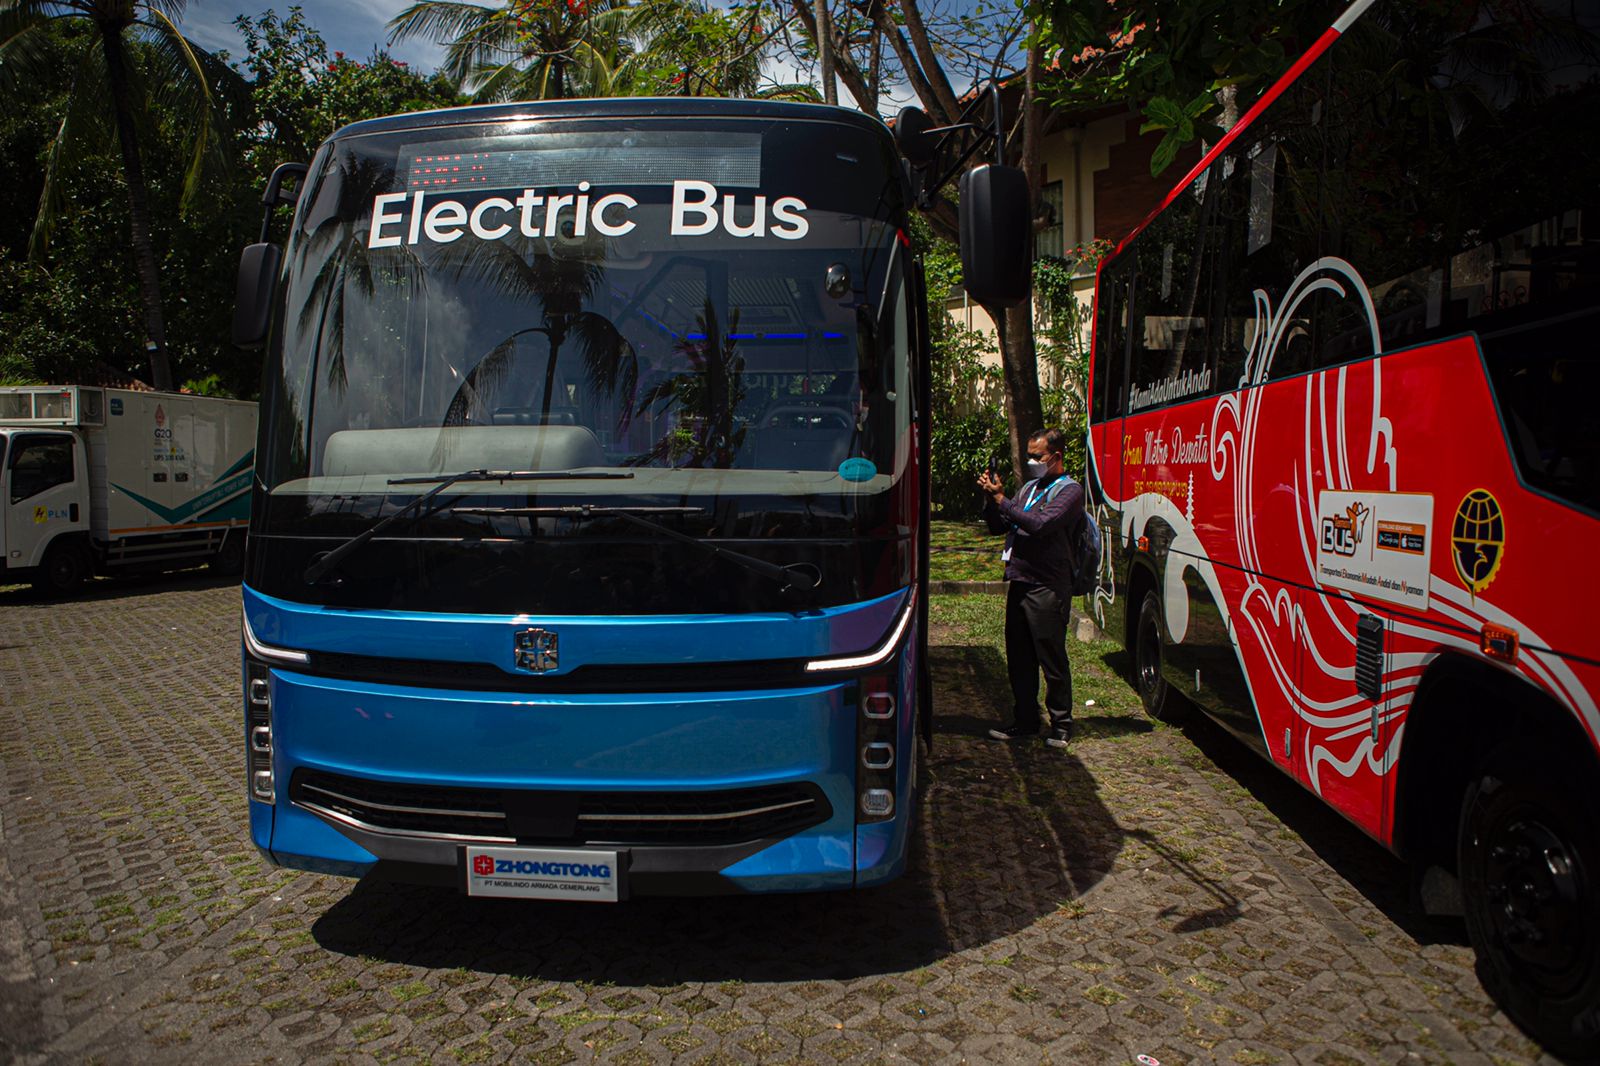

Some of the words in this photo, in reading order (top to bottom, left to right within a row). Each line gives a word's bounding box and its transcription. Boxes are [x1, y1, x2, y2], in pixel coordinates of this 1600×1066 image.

[368, 181, 638, 249] Electric
[670, 179, 810, 240] Bus
[154, 428, 172, 439] G20
[1123, 435, 1143, 465] Trans
[1144, 428, 1169, 465] Metro
[1171, 422, 1210, 465] Dewata
[48, 509, 68, 518] PLN
[1321, 517, 1356, 557] BUS
[1391, 580, 1401, 591] dan
[1401, 579, 1424, 596] Nyaman
[495, 860, 611, 878] ZHONGTONG
[494, 881, 530, 889] MOBILINDO
[530, 882, 558, 890] ARMADA
[559, 883, 600, 893] CEMERLANG
